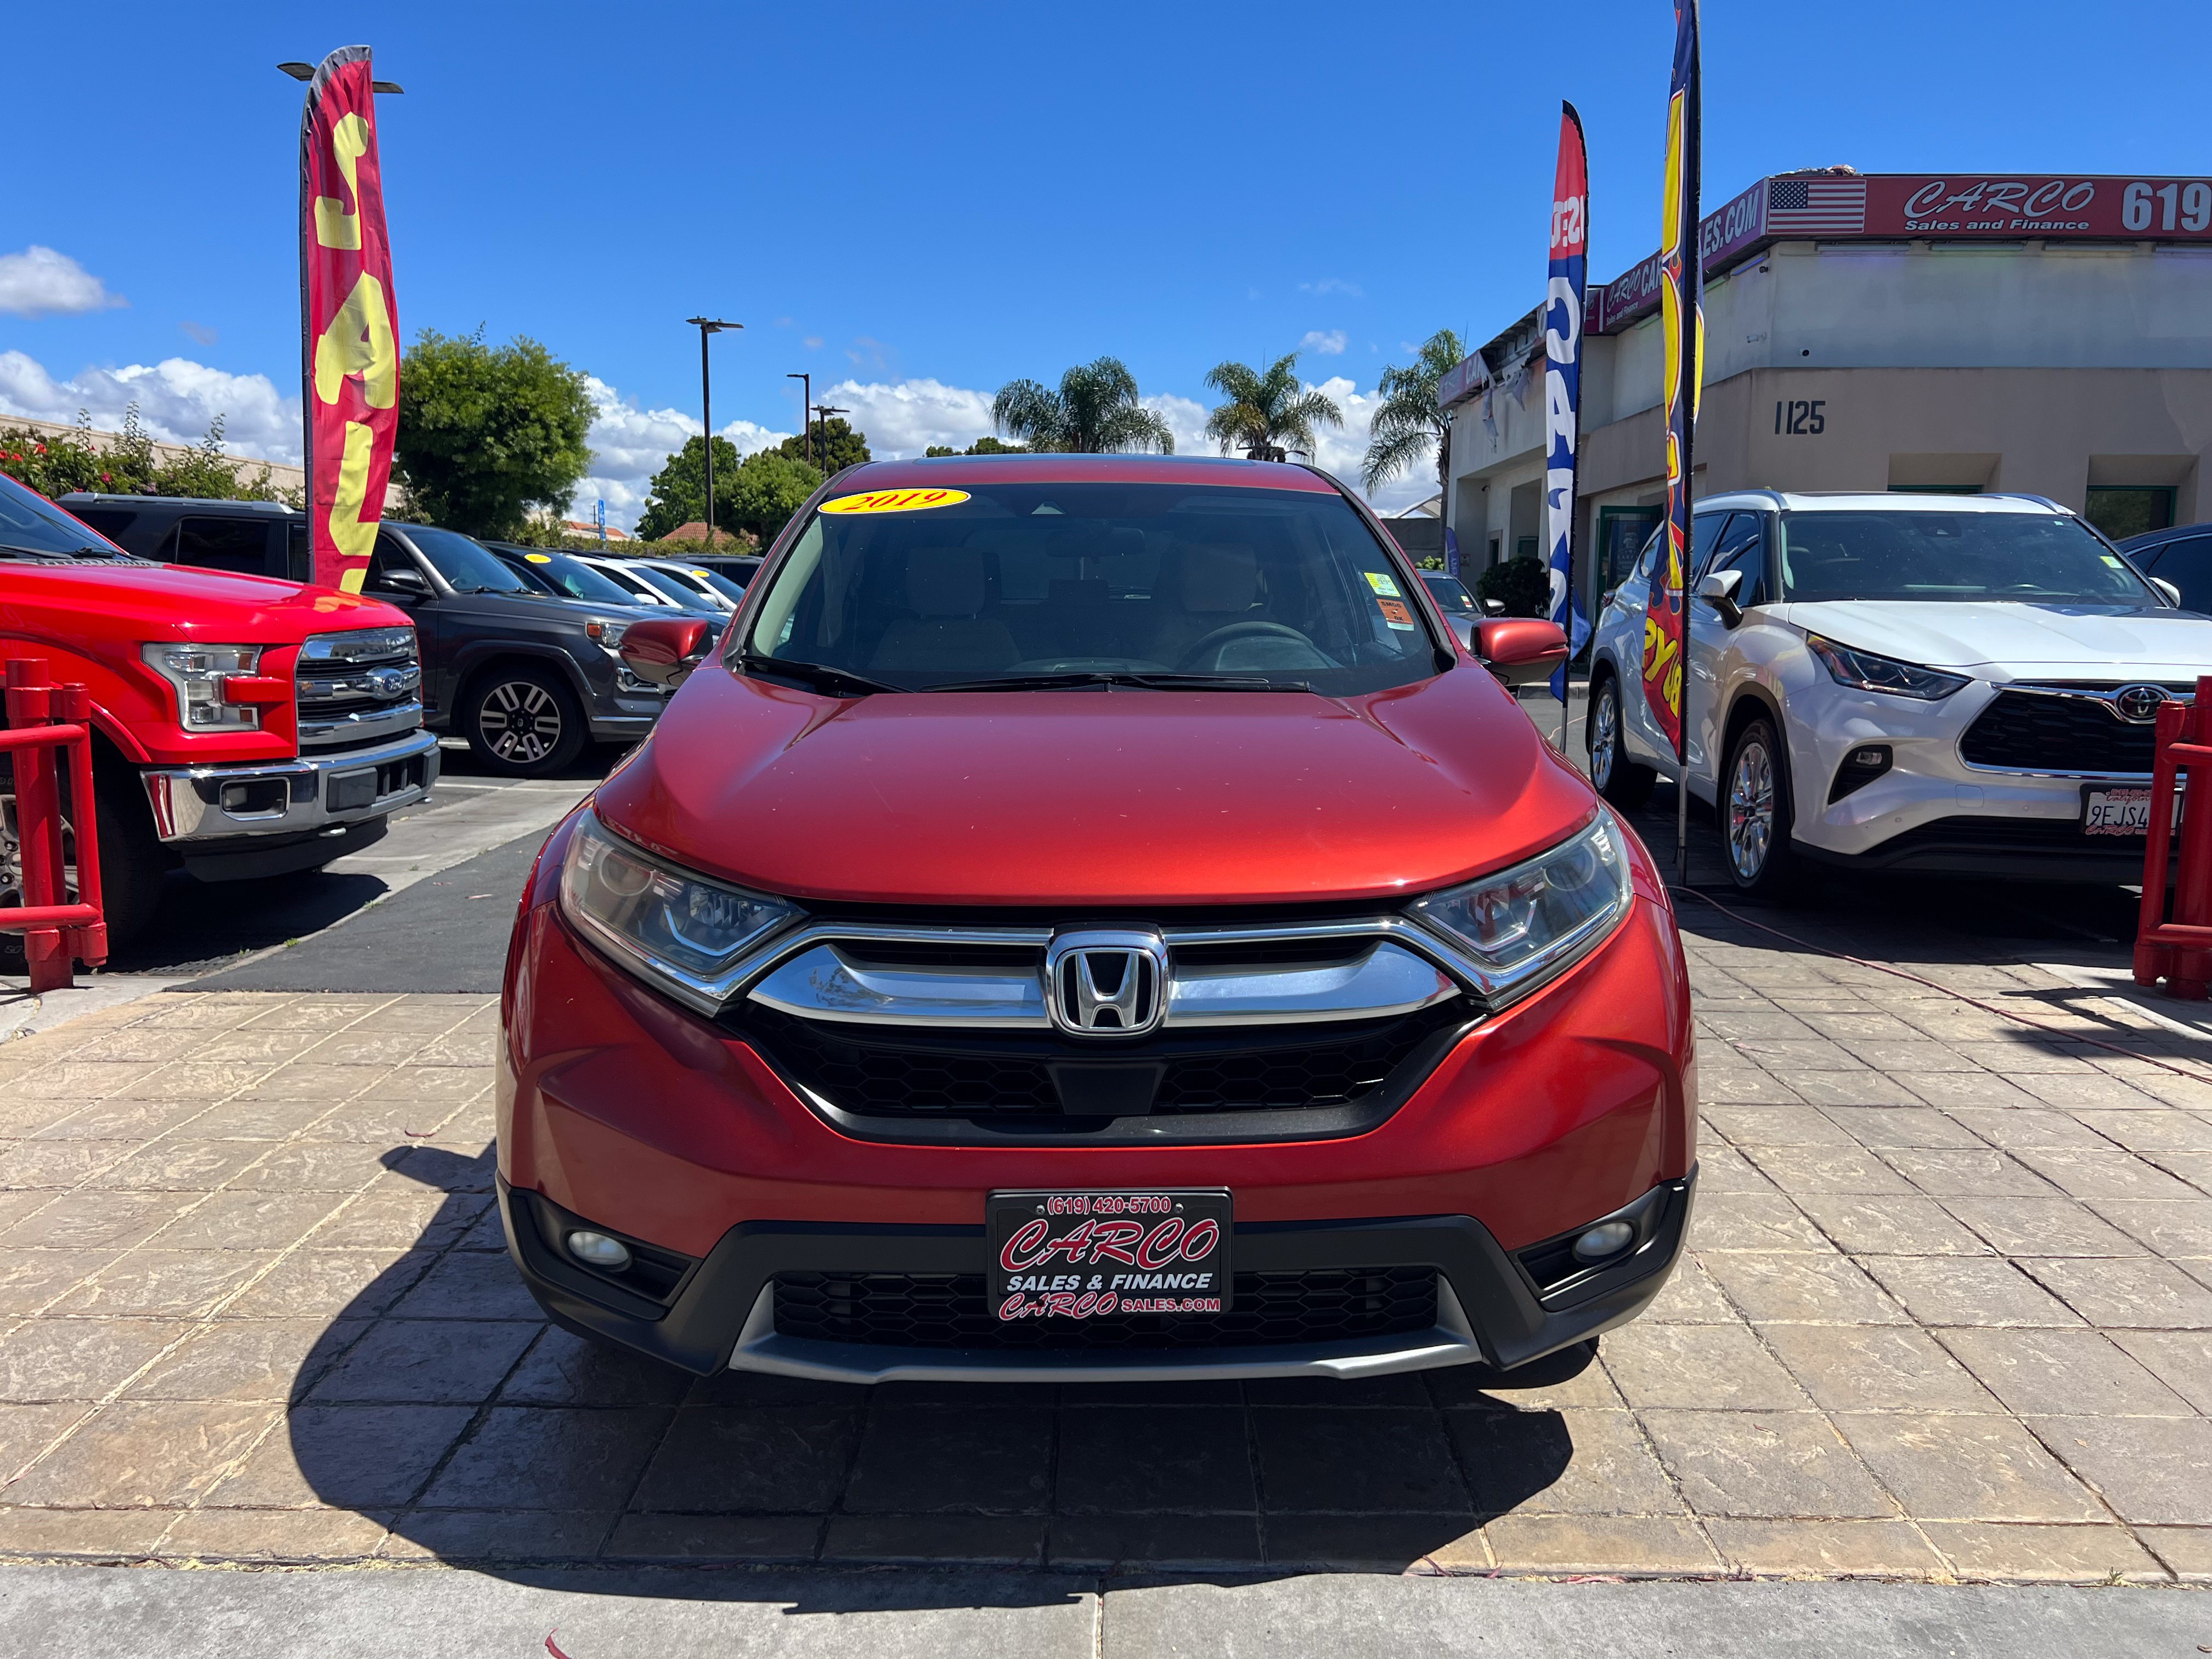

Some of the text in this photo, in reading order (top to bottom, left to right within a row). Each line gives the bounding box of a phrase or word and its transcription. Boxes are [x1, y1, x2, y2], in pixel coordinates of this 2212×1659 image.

[1904, 180, 2211, 231] CARCO 619
[1905, 219, 2089, 230] Sales and Finance
[1607, 268, 1640, 313] CARCO
[314, 111, 396, 594] SAL
[1775, 400, 1826, 435] 1125
[841, 492, 947, 511] 2019
[2107, 795, 2151, 805] Californ
[2090, 806, 2148, 828] 9EJS4
[1047, 1197, 1171, 1215] (619) 420-5700
[1000, 1217, 1219, 1272] CARCO
[1007, 1273, 1213, 1291] SALES & FINANCE
[999, 1291, 1220, 1321] CARCO SALES.COM
